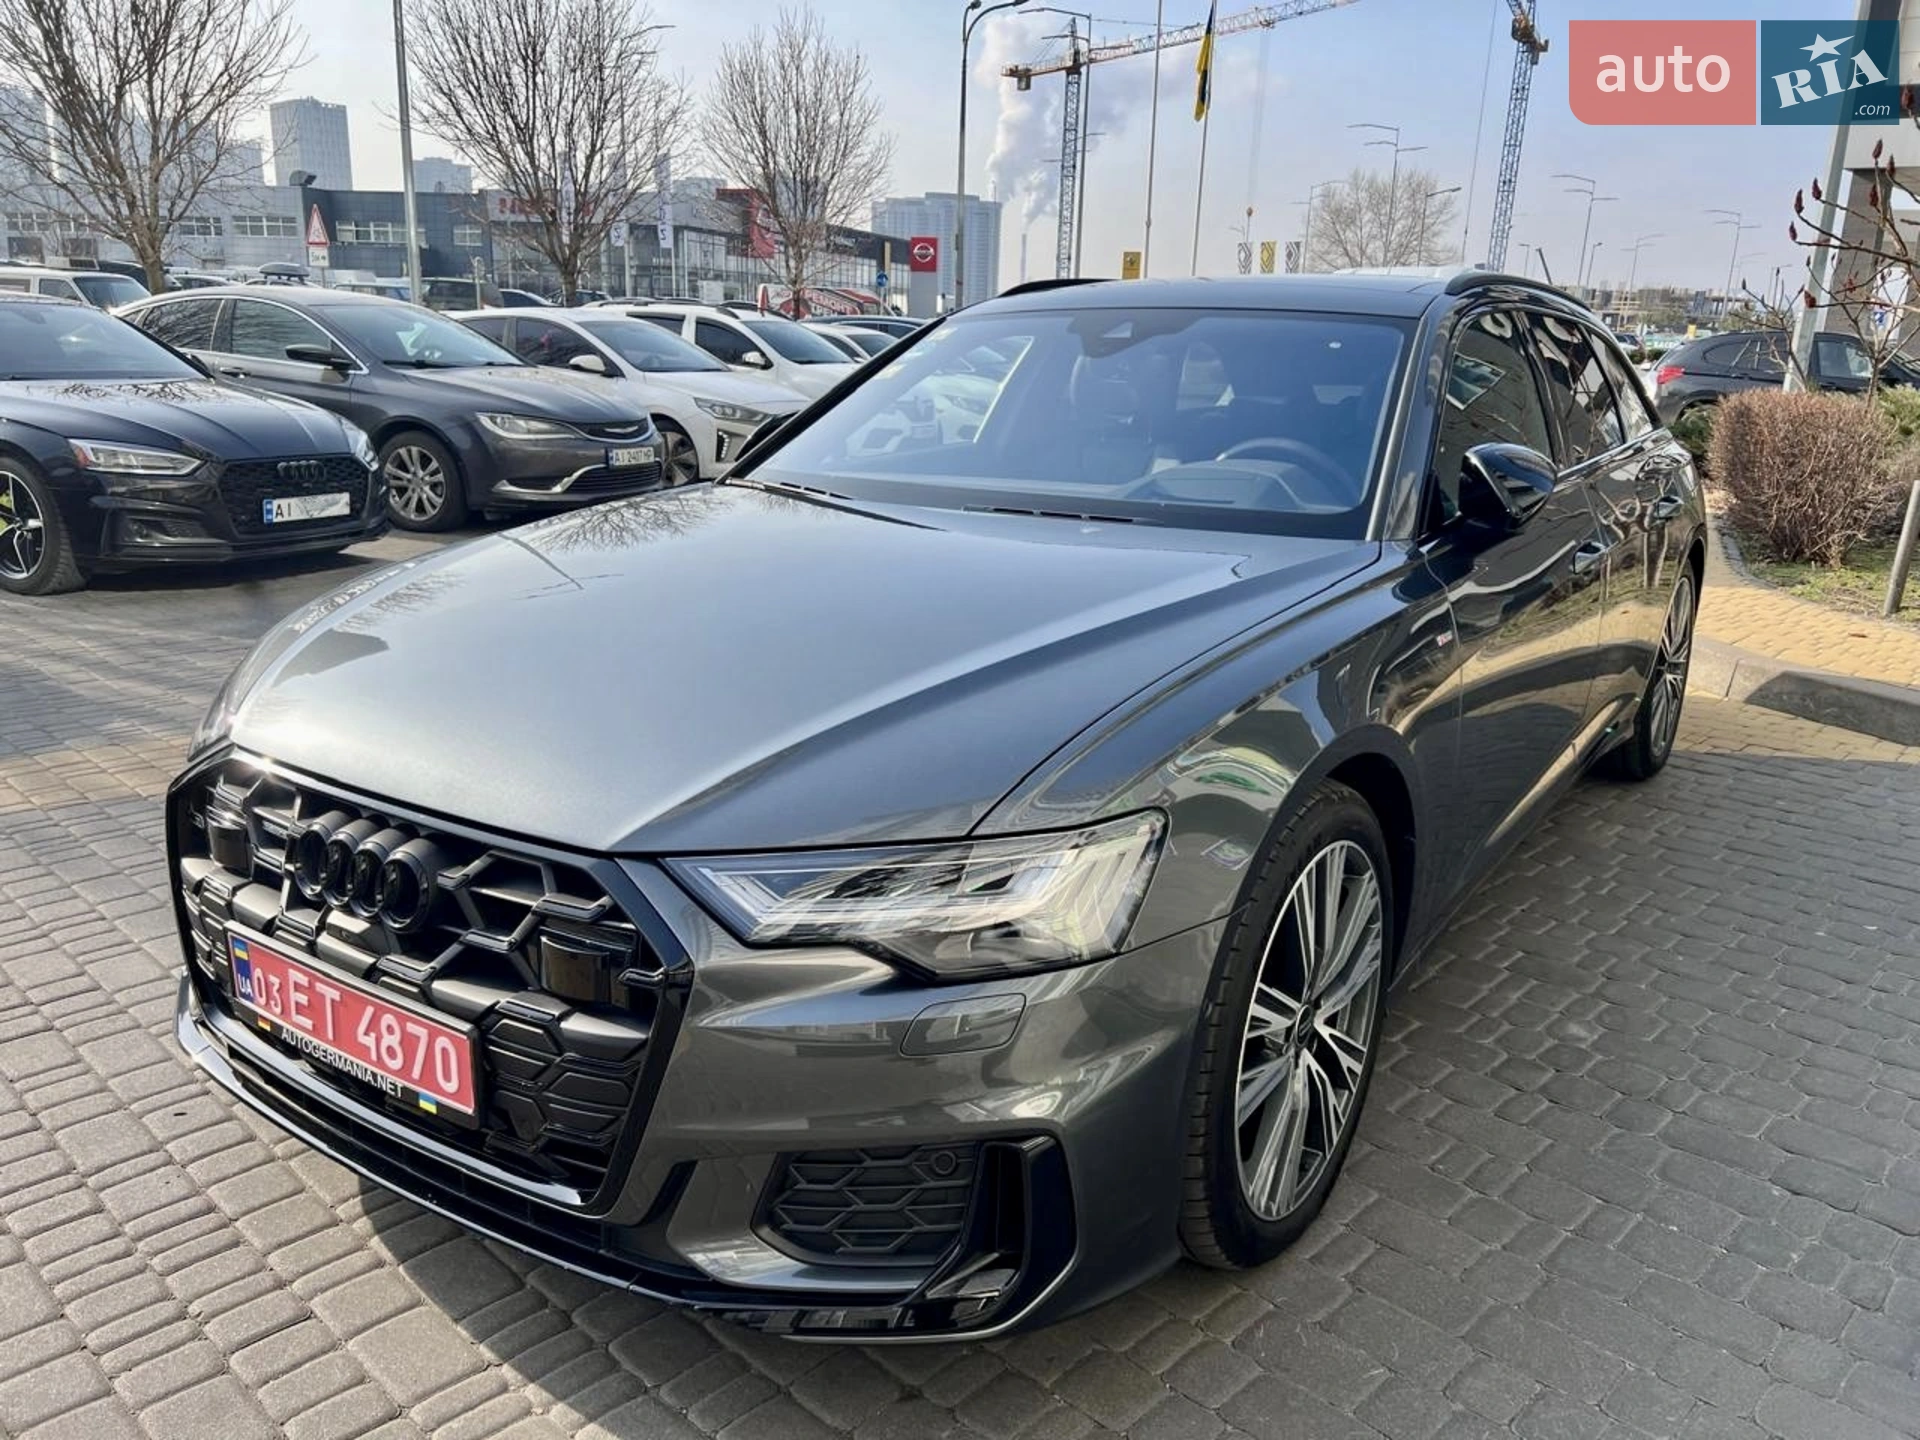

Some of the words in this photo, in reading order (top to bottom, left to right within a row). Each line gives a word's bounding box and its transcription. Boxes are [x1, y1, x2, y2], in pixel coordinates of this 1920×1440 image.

[237, 975, 253, 997] UA
[281, 1026, 403, 1099] AUTOGERMANIA.NET
[357, 1005, 459, 1094] 4870
